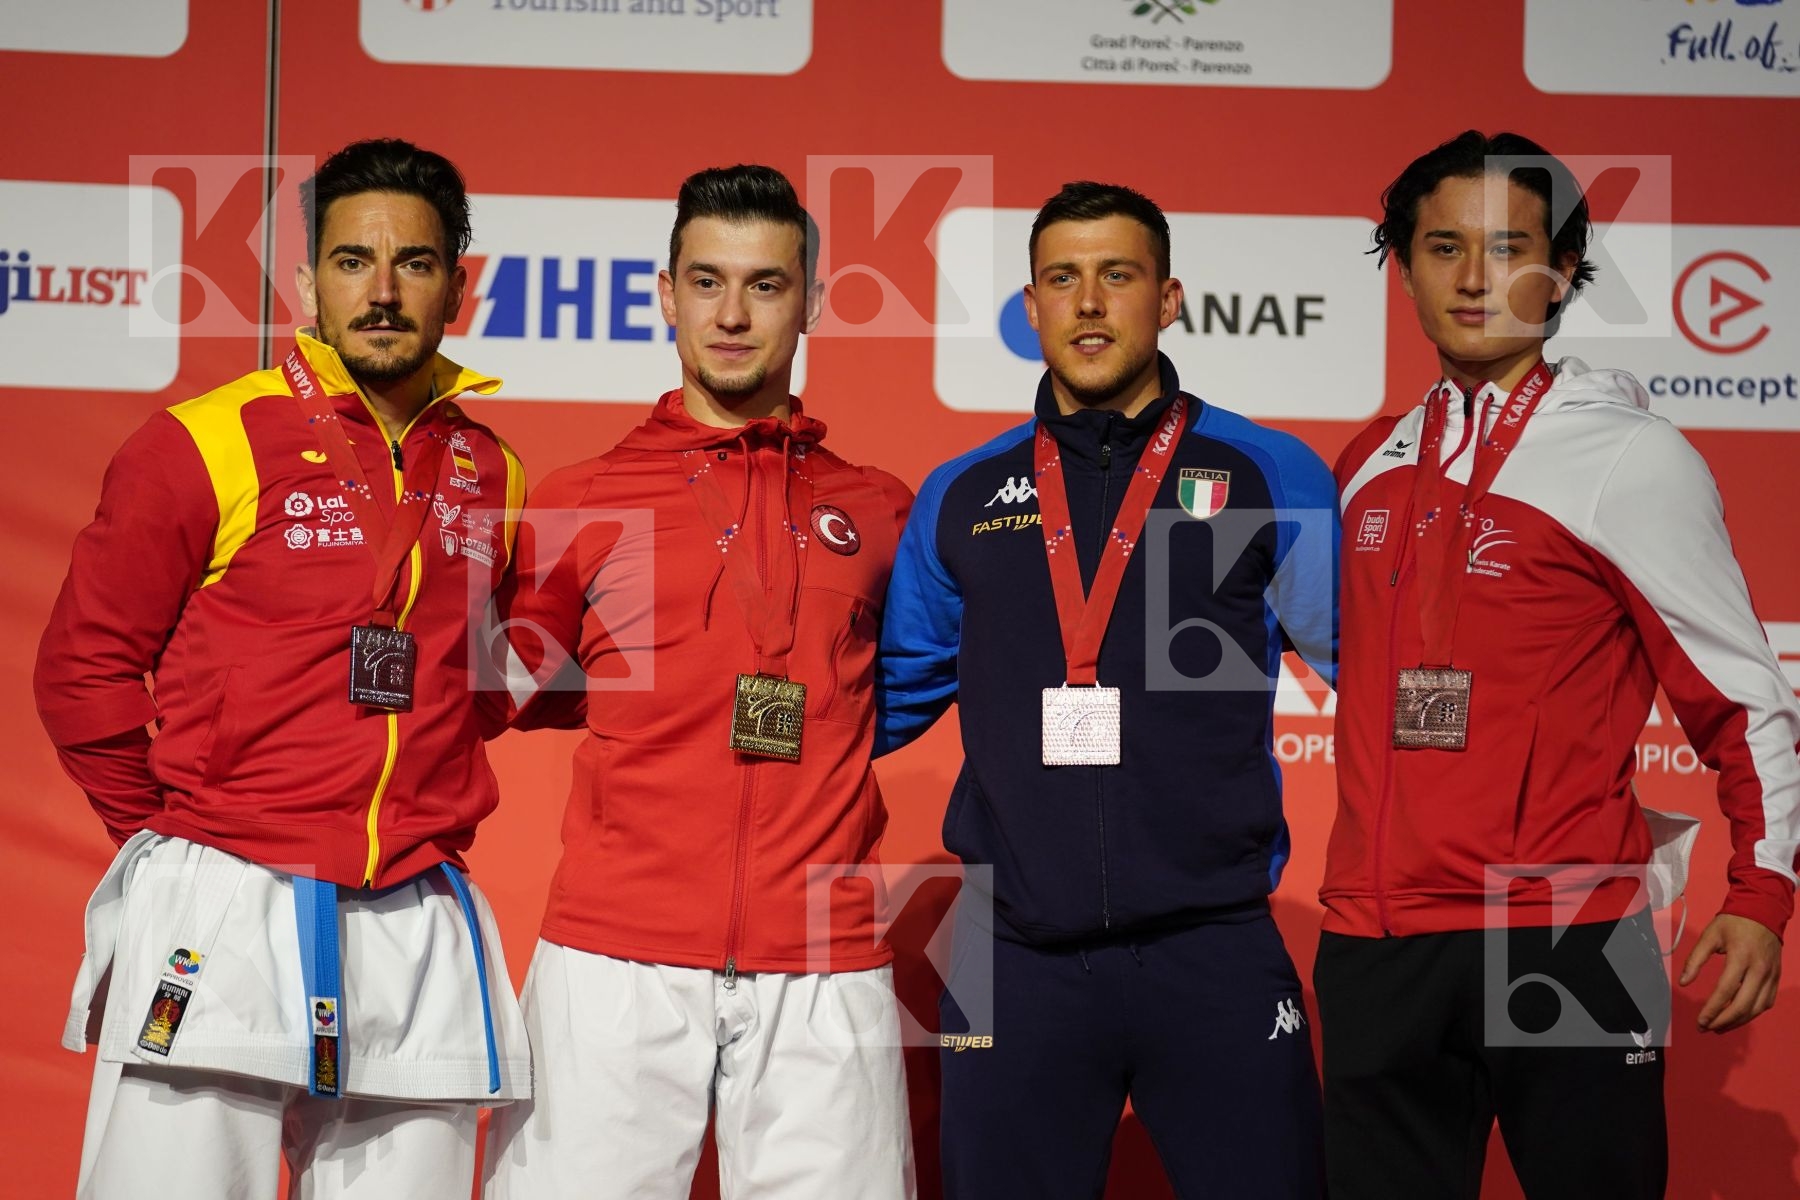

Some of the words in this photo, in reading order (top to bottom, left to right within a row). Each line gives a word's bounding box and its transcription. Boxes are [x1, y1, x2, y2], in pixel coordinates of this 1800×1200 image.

[629, 0, 685, 16] and
[1089, 33, 1127, 49] Grad
[1183, 36, 1245, 52] Parenzo
[1191, 59, 1253, 75] Parenzo
[286, 350, 317, 400] KARATE
[1649, 373, 1797, 404] concept
[1503, 373, 1544, 427] KARATE
[1185, 470, 1224, 480] ITALIA
[1366, 515, 1385, 524] budo
[1364, 524, 1383, 534] sport
[1489, 560, 1511, 571] Karate
[1274, 732, 1335, 764] OPE
[162, 971, 194, 987] APPROVED
[1625, 1049, 1657, 1065] erima
